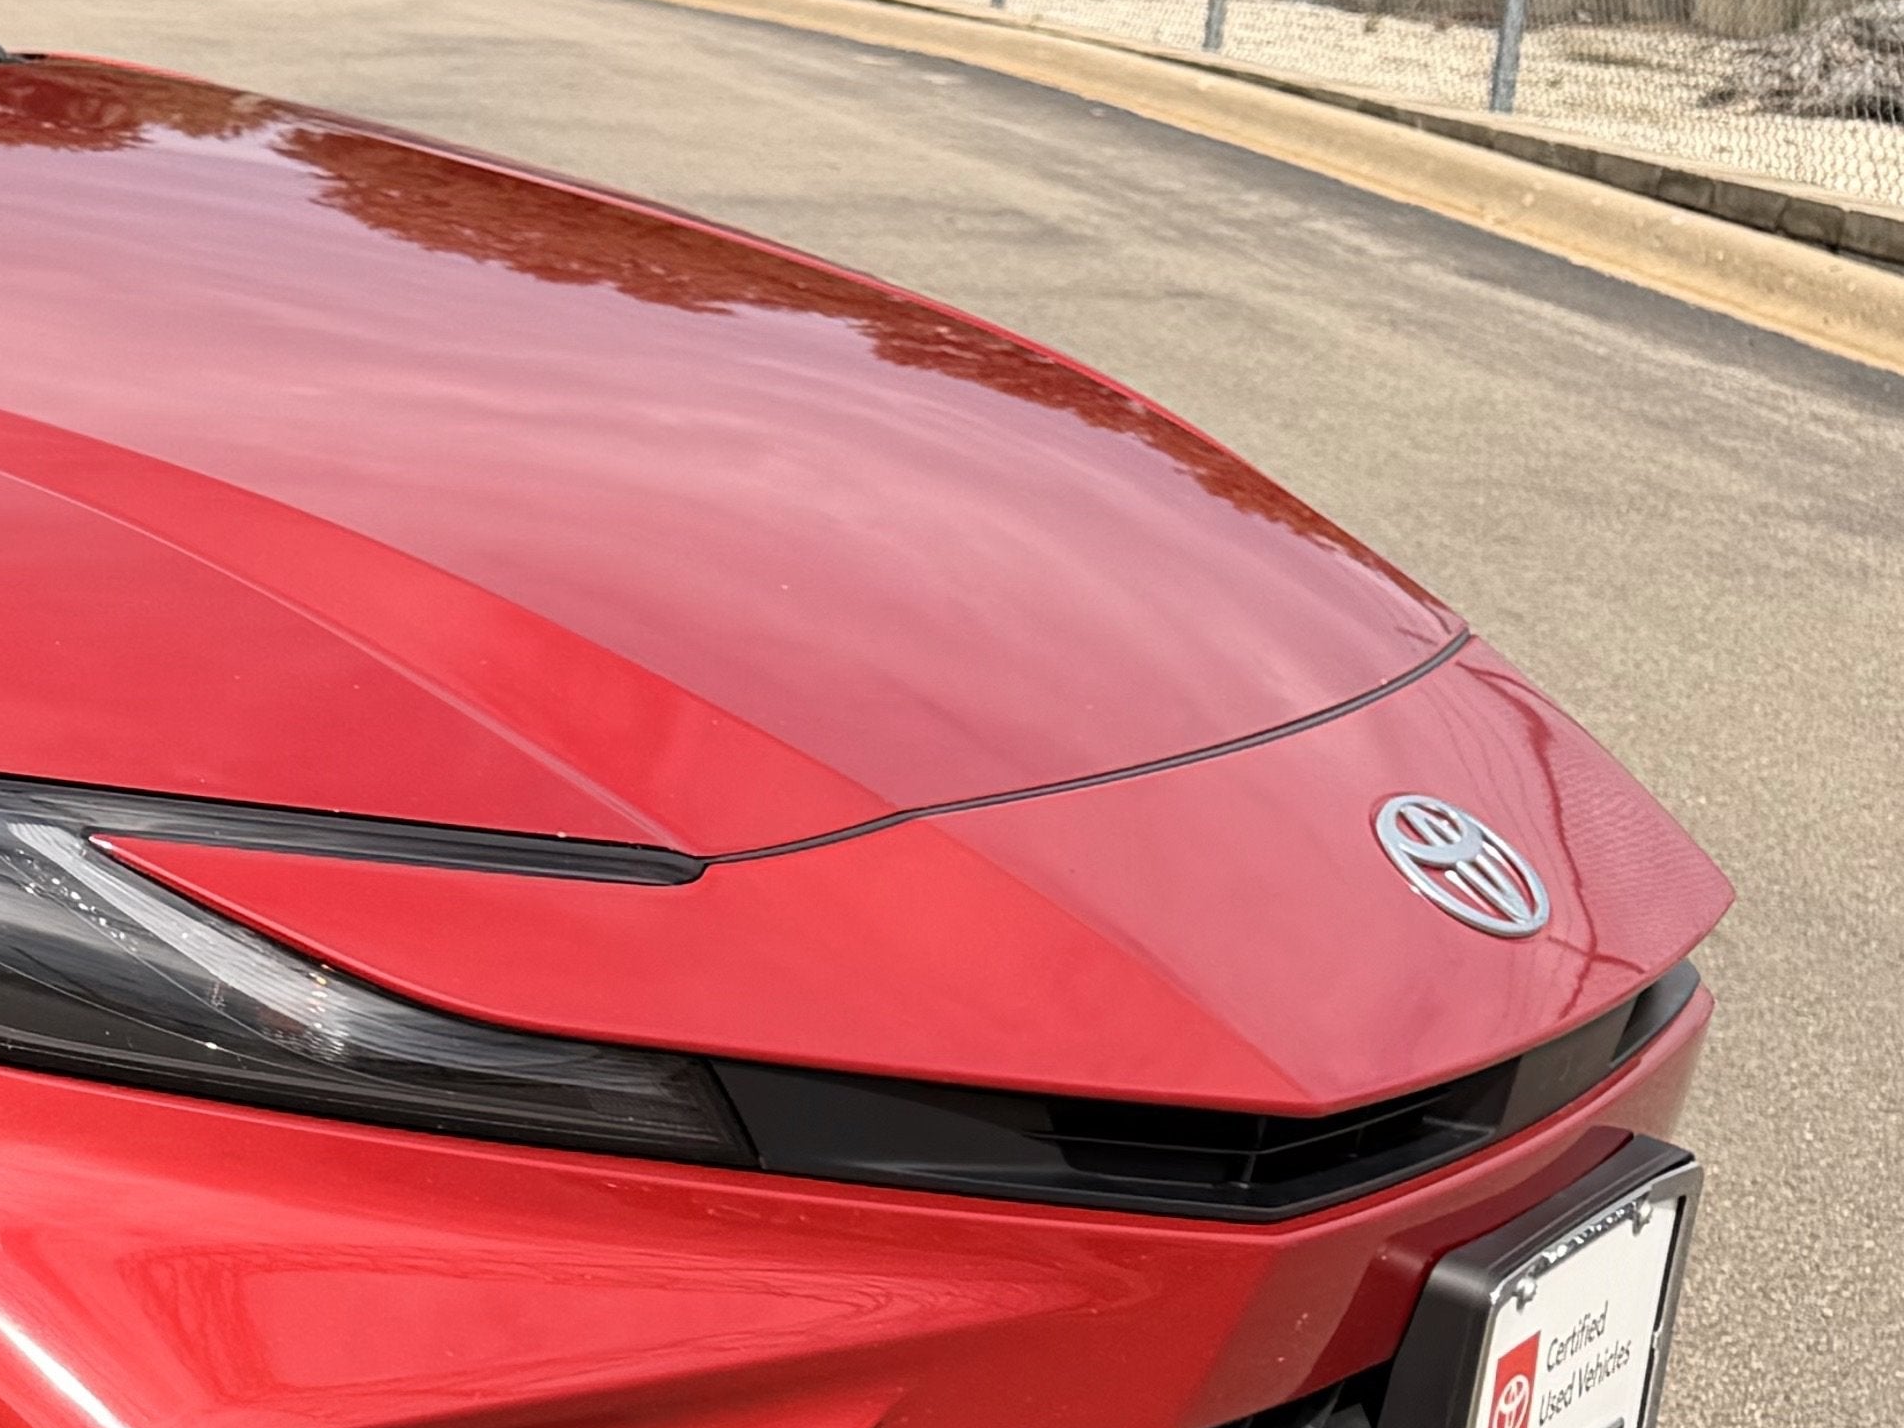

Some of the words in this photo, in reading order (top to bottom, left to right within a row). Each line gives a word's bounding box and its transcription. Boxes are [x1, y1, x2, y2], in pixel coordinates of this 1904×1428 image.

[1546, 1299, 1609, 1373] Certified
[1538, 1369, 1576, 1427] Used
[1578, 1339, 1632, 1399] Vehicles
